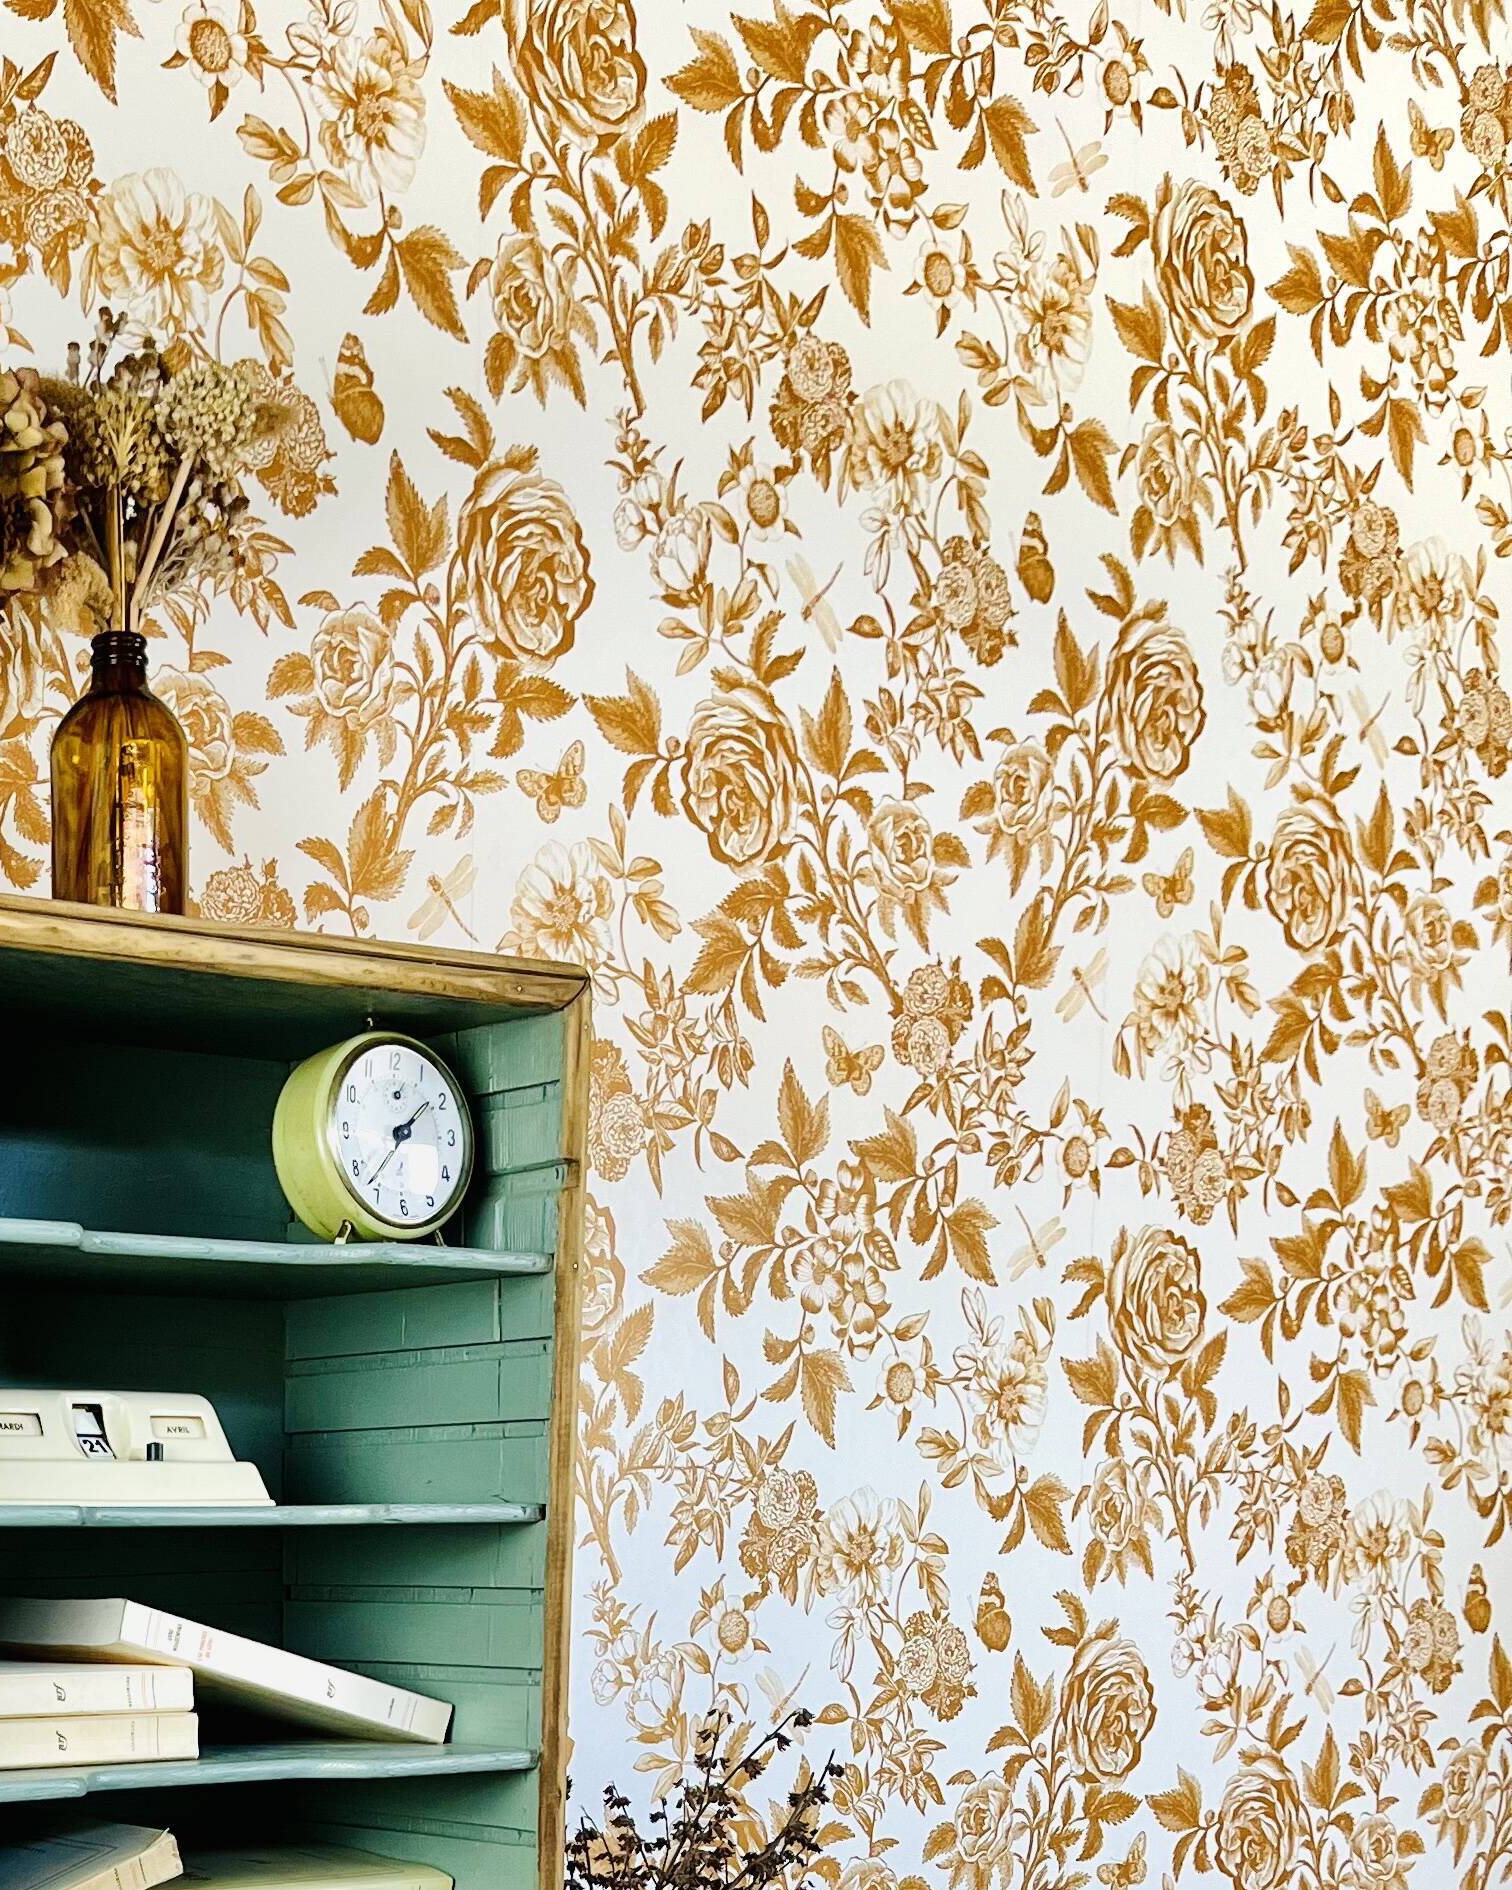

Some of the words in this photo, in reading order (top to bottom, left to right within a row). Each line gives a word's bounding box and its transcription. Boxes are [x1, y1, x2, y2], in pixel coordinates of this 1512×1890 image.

[365, 1059, 373, 1078] 11
[389, 1052, 401, 1071] 12
[419, 1064, 424, 1082] 1
[346, 1085, 356, 1104] 10
[438, 1092, 447, 1111] 2
[342, 1121, 350, 1140] 9
[447, 1129, 456, 1147] 3
[352, 1159, 360, 1177] 8
[441, 1165, 451, 1182] 4
[373, 1187, 380, 1205] 7
[399, 1199, 409, 1217] 6
[82, 1439, 108, 1453] 21
